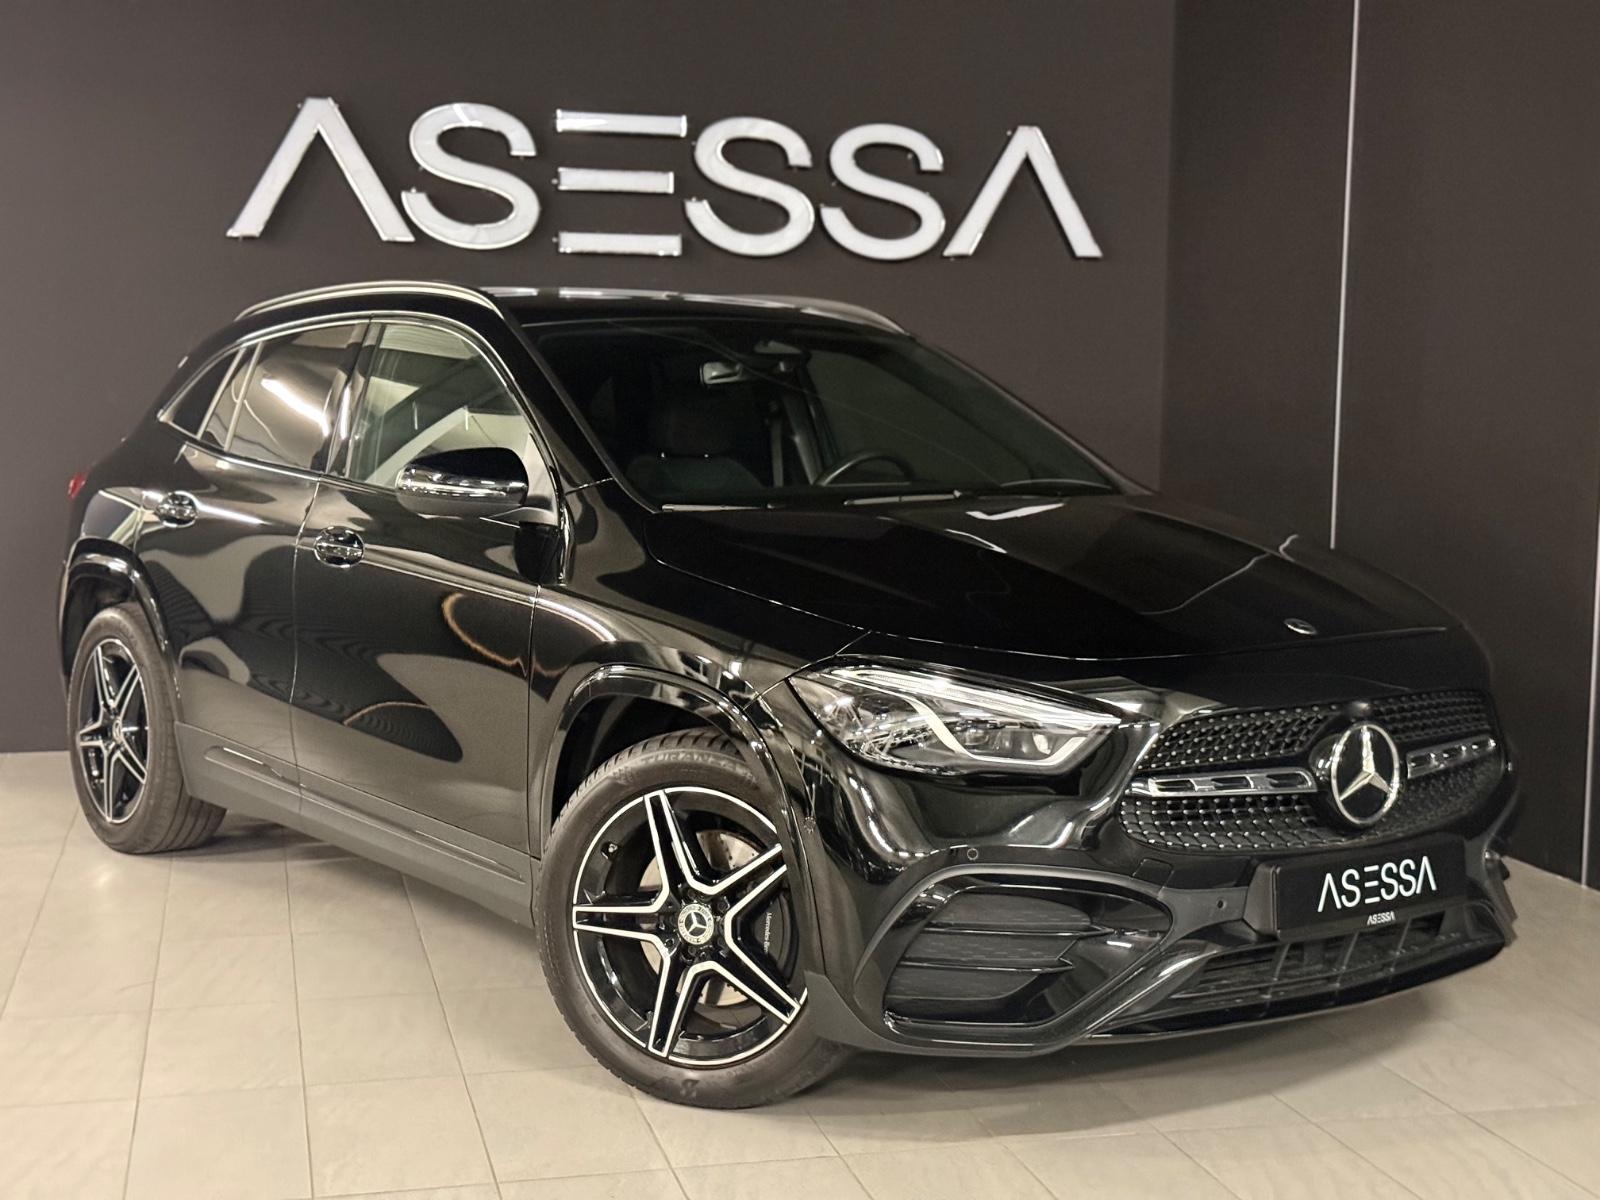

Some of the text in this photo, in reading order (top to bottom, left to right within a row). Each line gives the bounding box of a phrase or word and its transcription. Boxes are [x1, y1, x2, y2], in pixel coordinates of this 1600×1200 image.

[226, 97, 1102, 260] ASESSA
[1317, 856, 1438, 913] ASESSA
[1366, 911, 1396, 926] ASESSA
